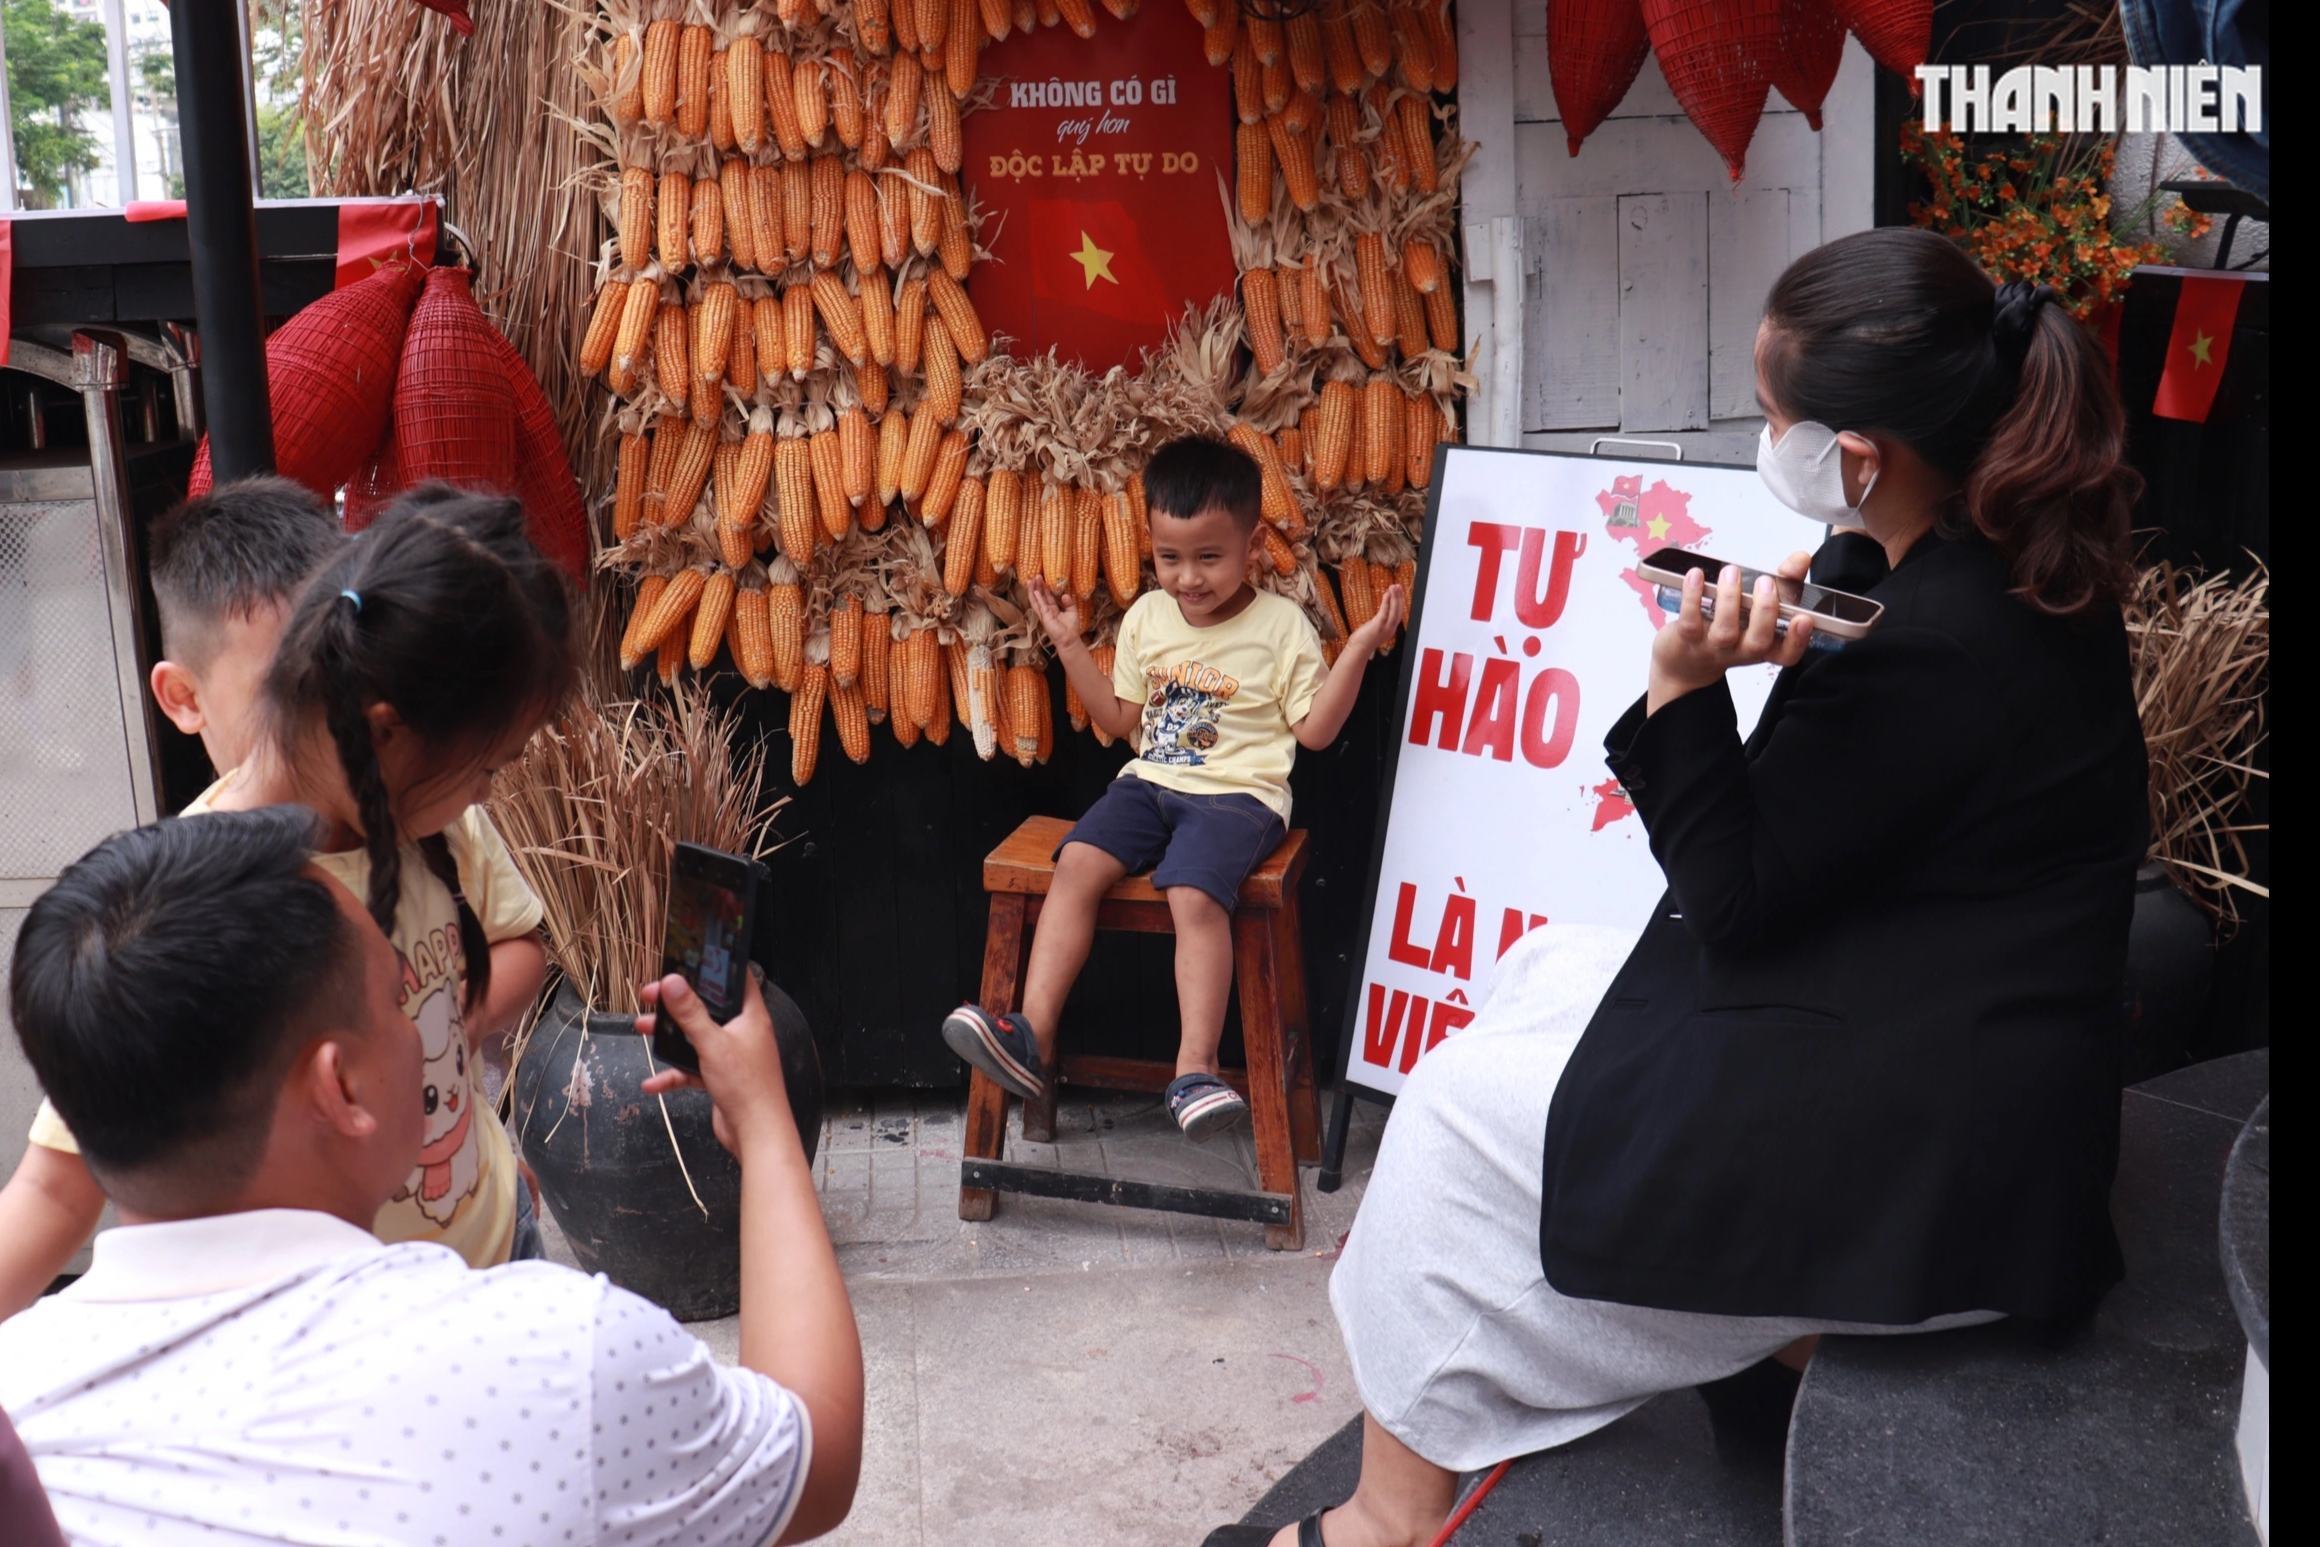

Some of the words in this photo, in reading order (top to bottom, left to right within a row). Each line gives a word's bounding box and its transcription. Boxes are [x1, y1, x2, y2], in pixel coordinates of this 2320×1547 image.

[1010, 76, 1102, 108] KHÔNG
[1110, 74, 1143, 105] CÓ
[1151, 74, 1177, 105] GÌ
[989, 148, 1043, 184] ĐỘC
[1051, 147, 1106, 183] LẬP
[1114, 152, 1153, 181] TỰ
[1161, 151, 1199, 175] DO
[1057, 117, 1094, 145] quý
[1467, 521, 1587, 657] TỰ
[1408, 635, 1581, 769] HÀO
[1388, 876, 1476, 982] LÀ
